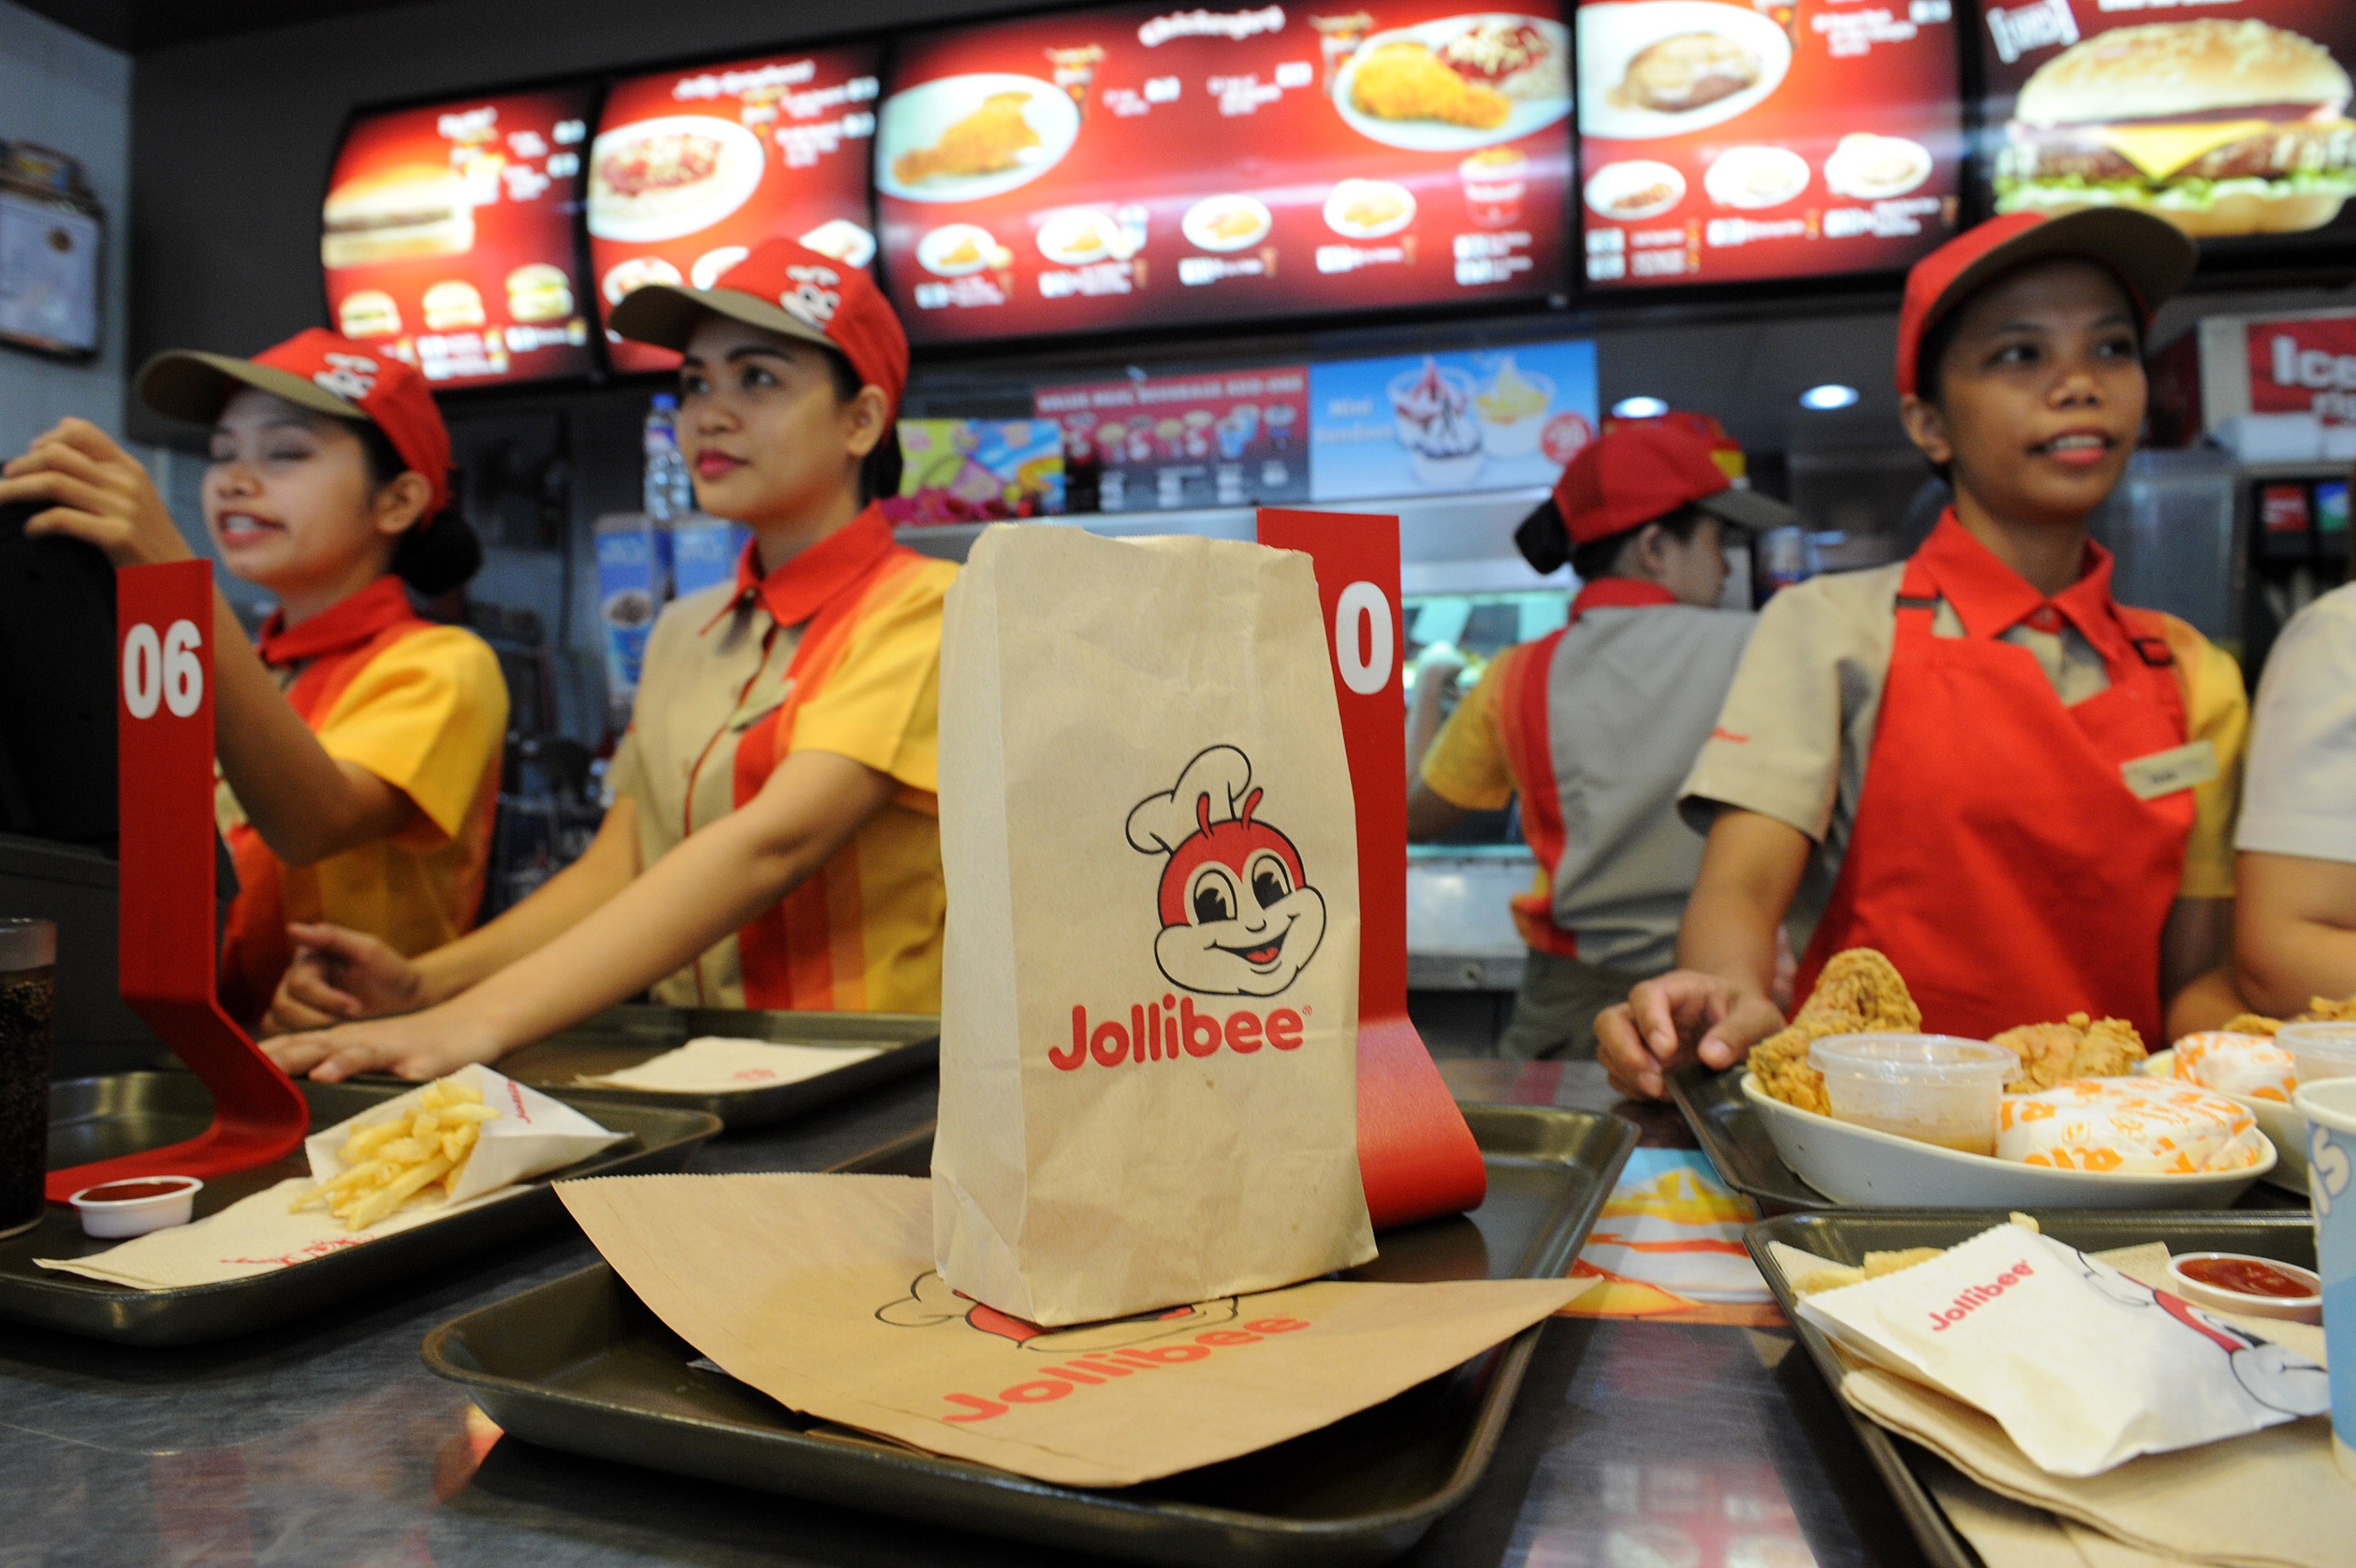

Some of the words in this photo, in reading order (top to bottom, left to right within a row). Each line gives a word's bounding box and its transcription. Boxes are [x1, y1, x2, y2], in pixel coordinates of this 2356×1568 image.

[123, 619, 204, 719] 06
[1048, 993, 1305, 1072] Jollibee
[1928, 1262, 2034, 1331] Jollibee
[942, 1318, 1310, 1423] Jollibee
